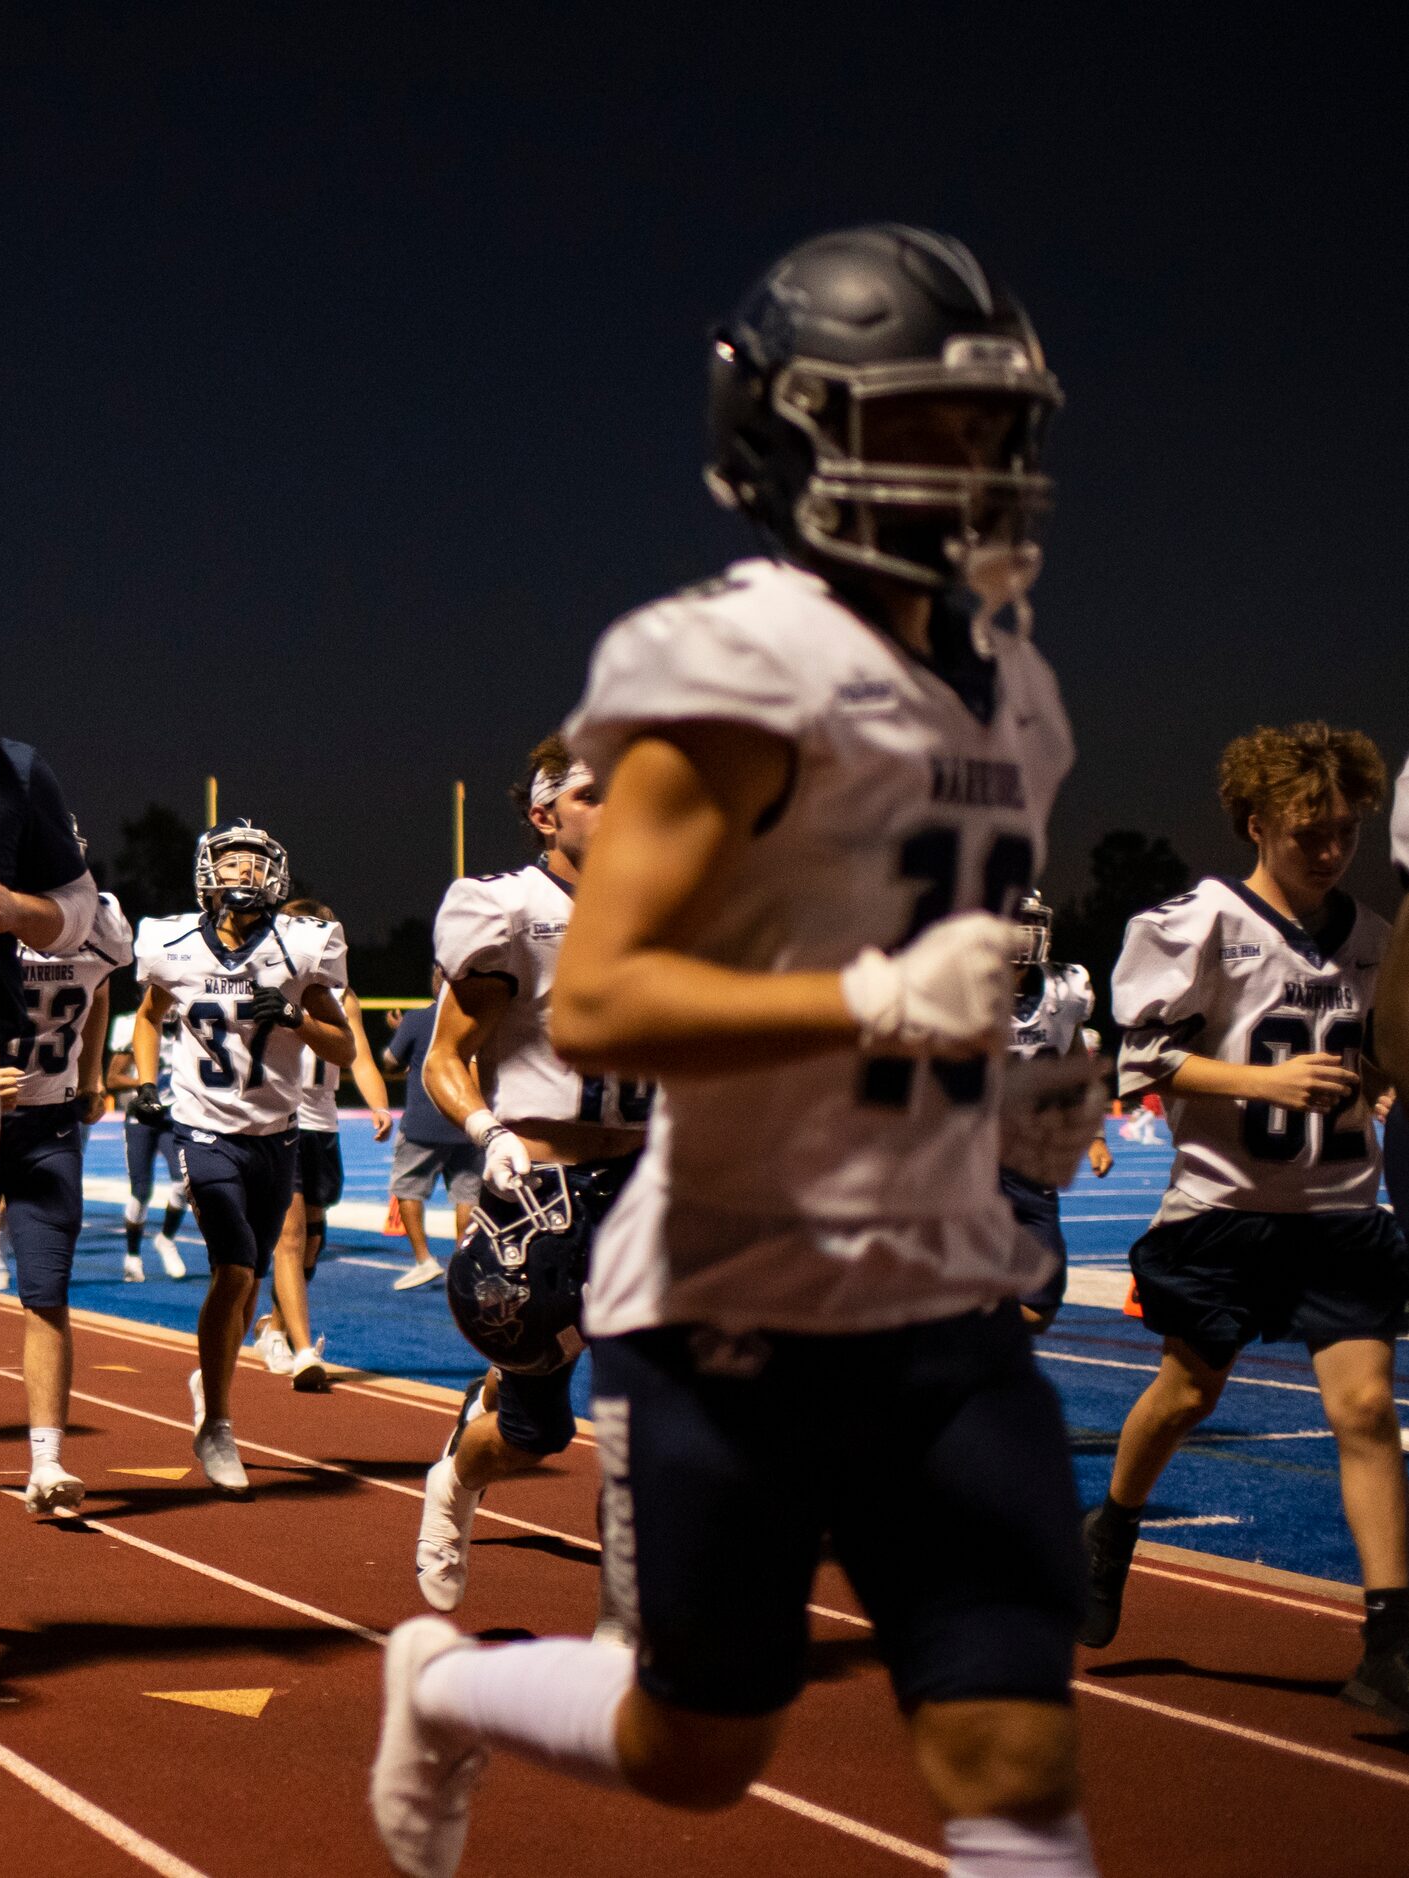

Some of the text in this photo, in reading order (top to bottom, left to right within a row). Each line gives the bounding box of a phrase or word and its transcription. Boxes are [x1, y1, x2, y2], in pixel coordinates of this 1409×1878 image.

[204, 976, 253, 994] WARRIOR
[1285, 982, 1352, 1010] WARRIORS
[187, 1001, 278, 1090] 37
